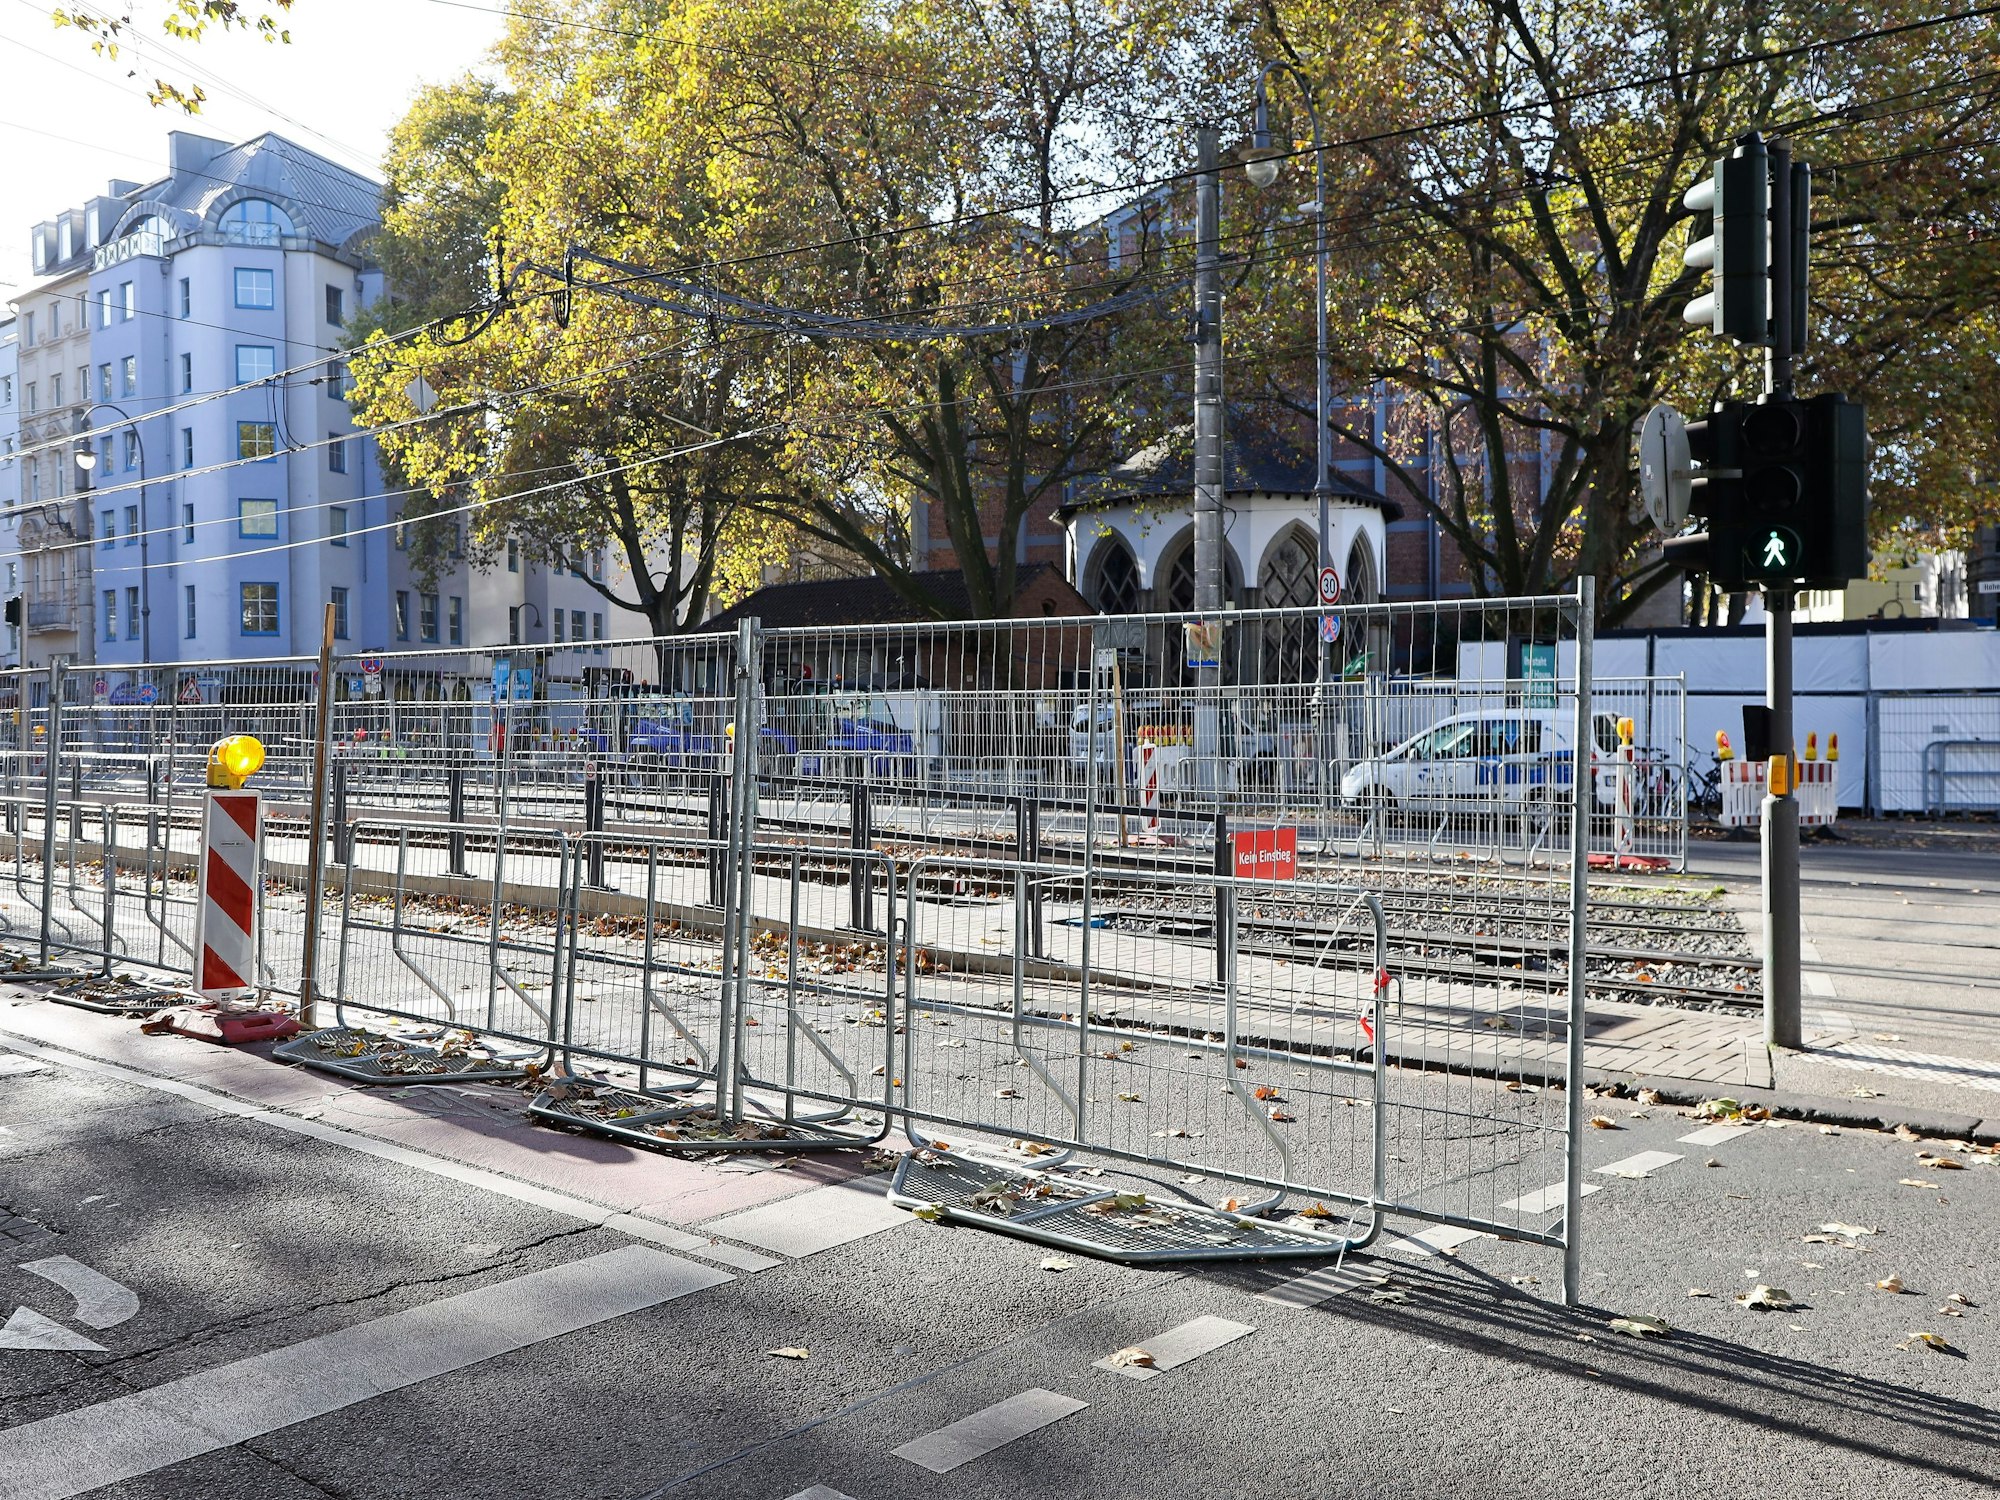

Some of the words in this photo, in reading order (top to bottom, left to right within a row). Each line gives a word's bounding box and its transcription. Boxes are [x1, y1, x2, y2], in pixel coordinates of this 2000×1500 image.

[1323, 578, 1336, 594] 30
[1239, 851, 1258, 865] Kein
[1260, 848, 1291, 863] Einstieg
